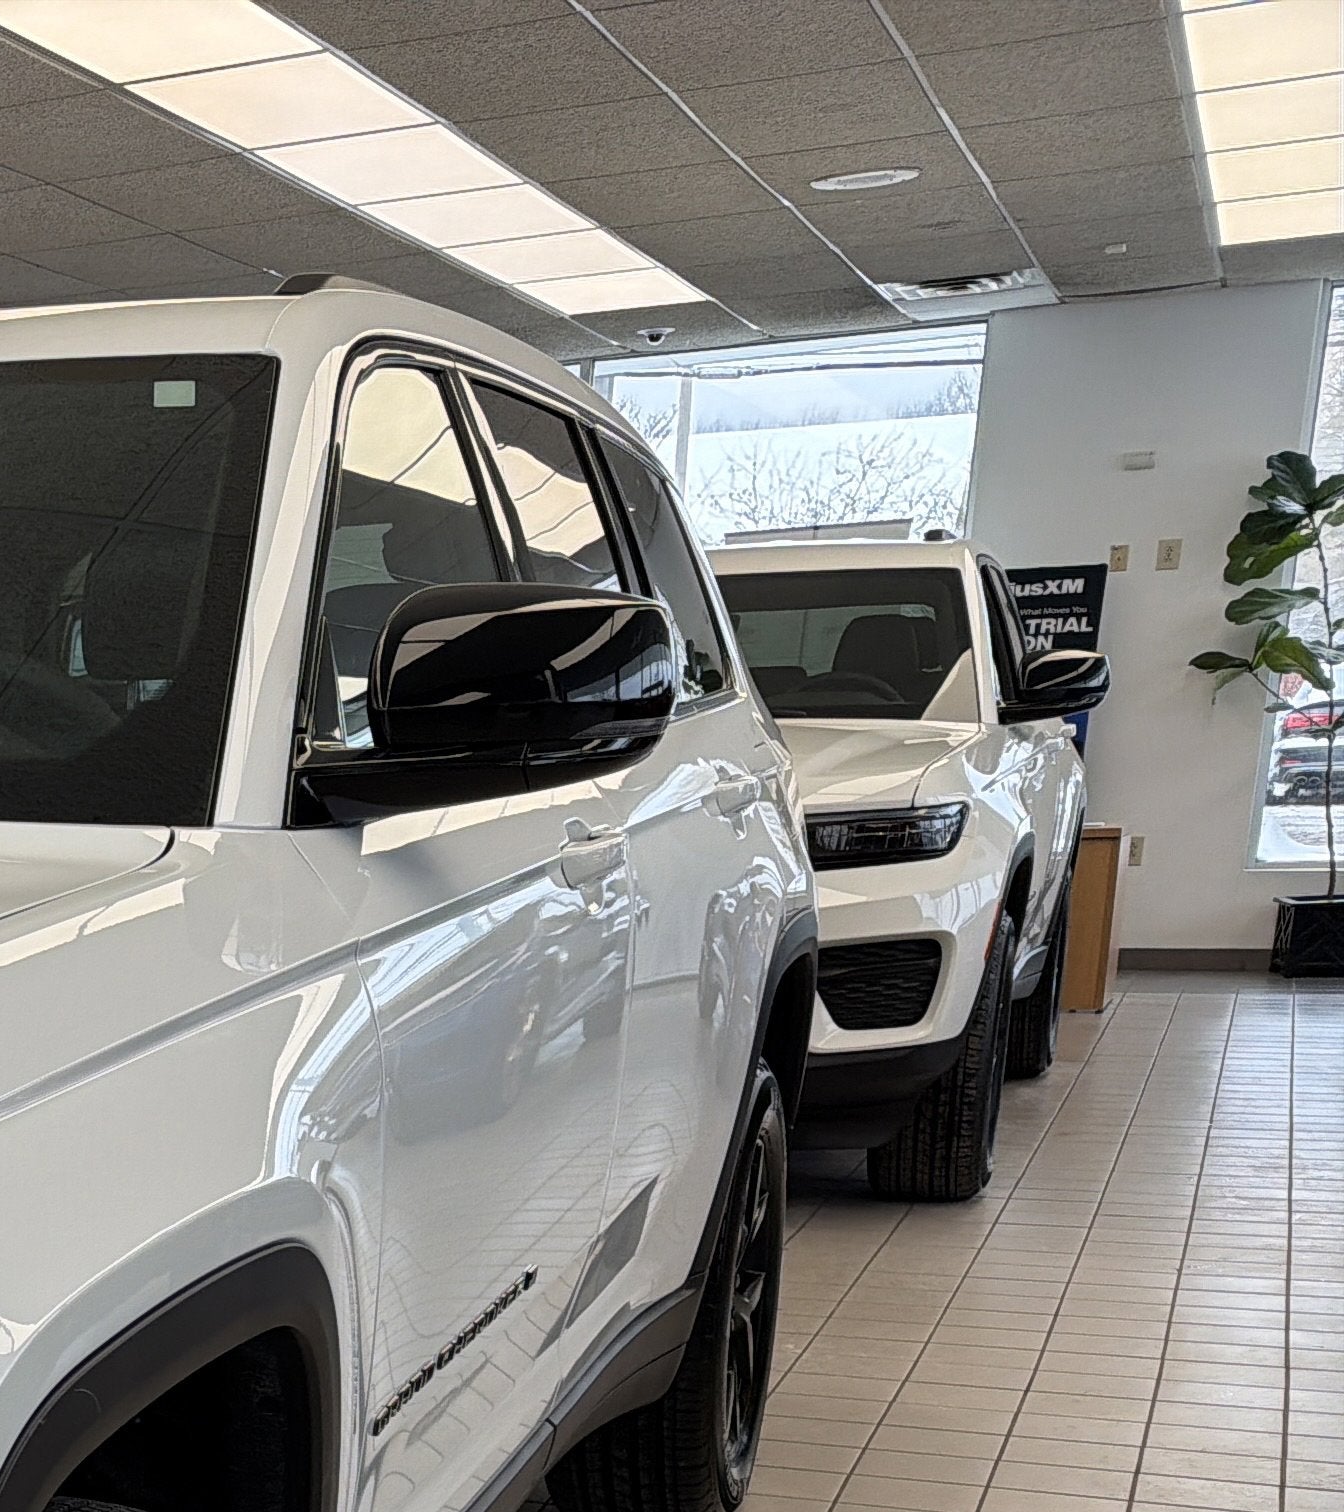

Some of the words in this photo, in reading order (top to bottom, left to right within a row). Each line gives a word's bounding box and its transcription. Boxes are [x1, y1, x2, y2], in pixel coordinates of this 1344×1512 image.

[1010, 578, 1085, 597] iusXM
[1072, 605, 1088, 614] You
[1025, 616, 1094, 635] TRIAL
